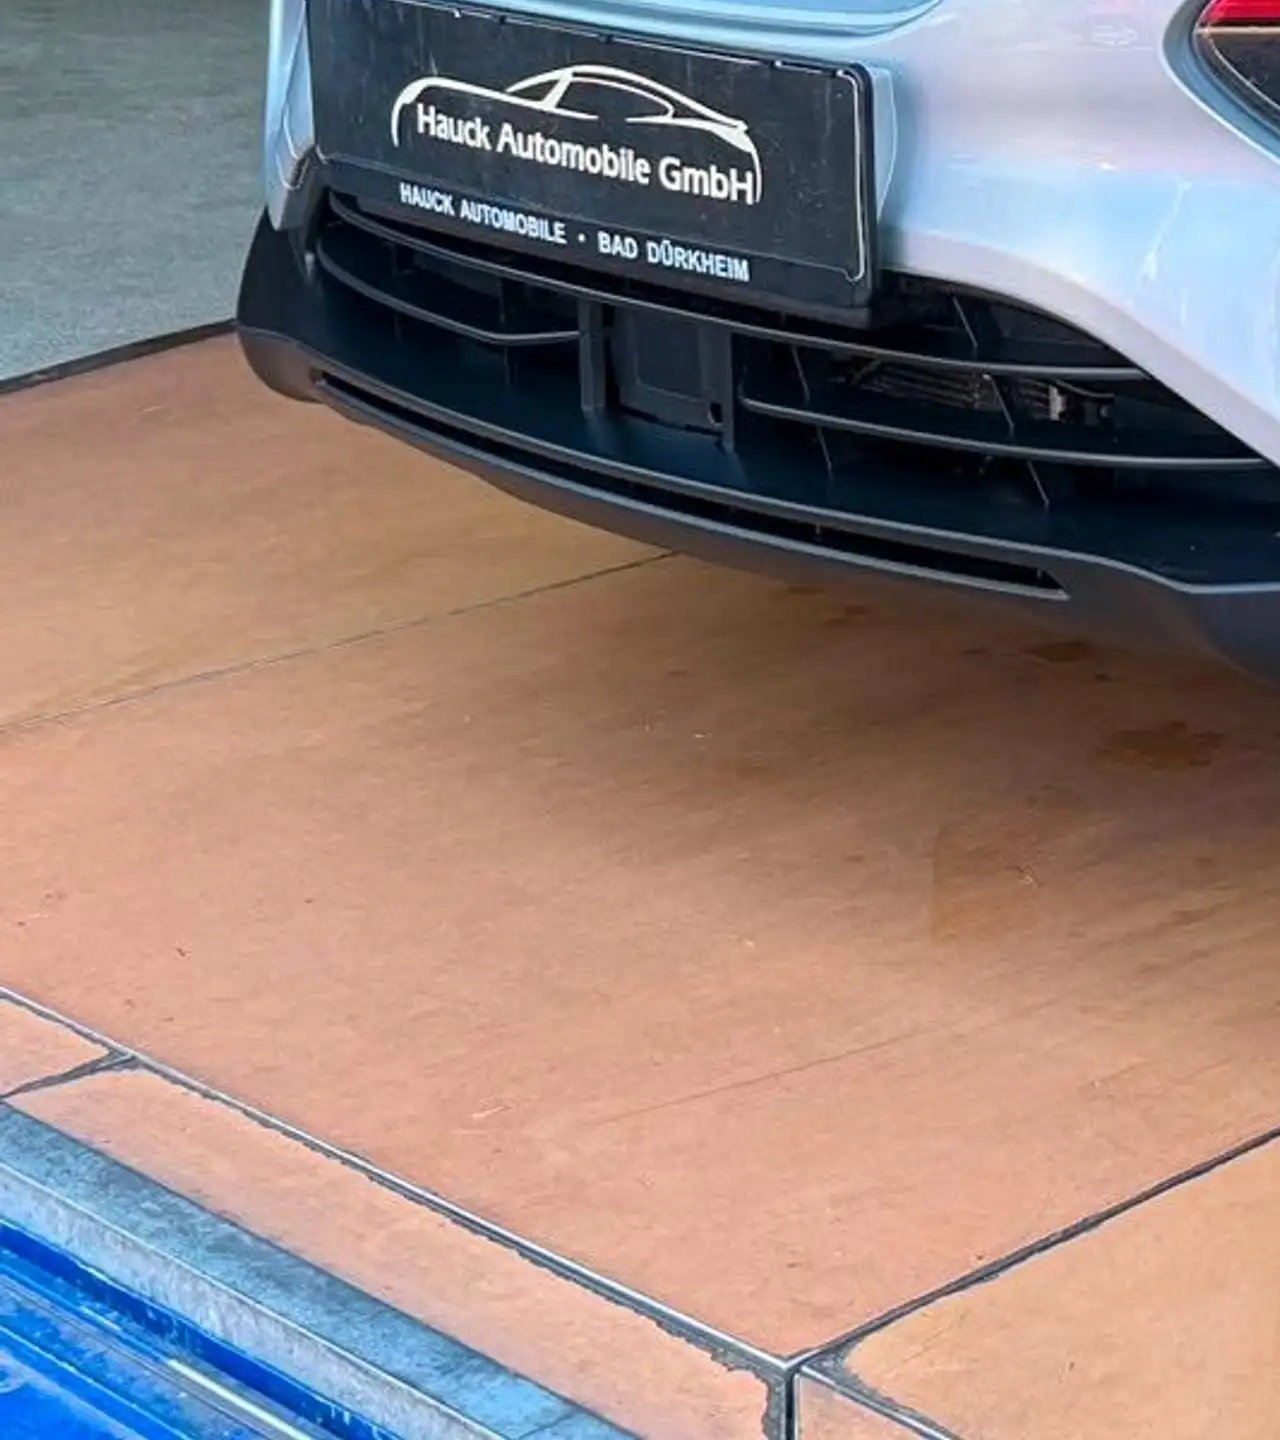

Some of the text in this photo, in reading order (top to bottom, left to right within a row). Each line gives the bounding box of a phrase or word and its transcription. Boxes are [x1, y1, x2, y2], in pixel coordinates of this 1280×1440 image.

[416, 104, 754, 205] Hauck Automobile GmbH
[399, 182, 750, 282] HAUCK AUTOMOBILE BAD DÜRKHEIM
